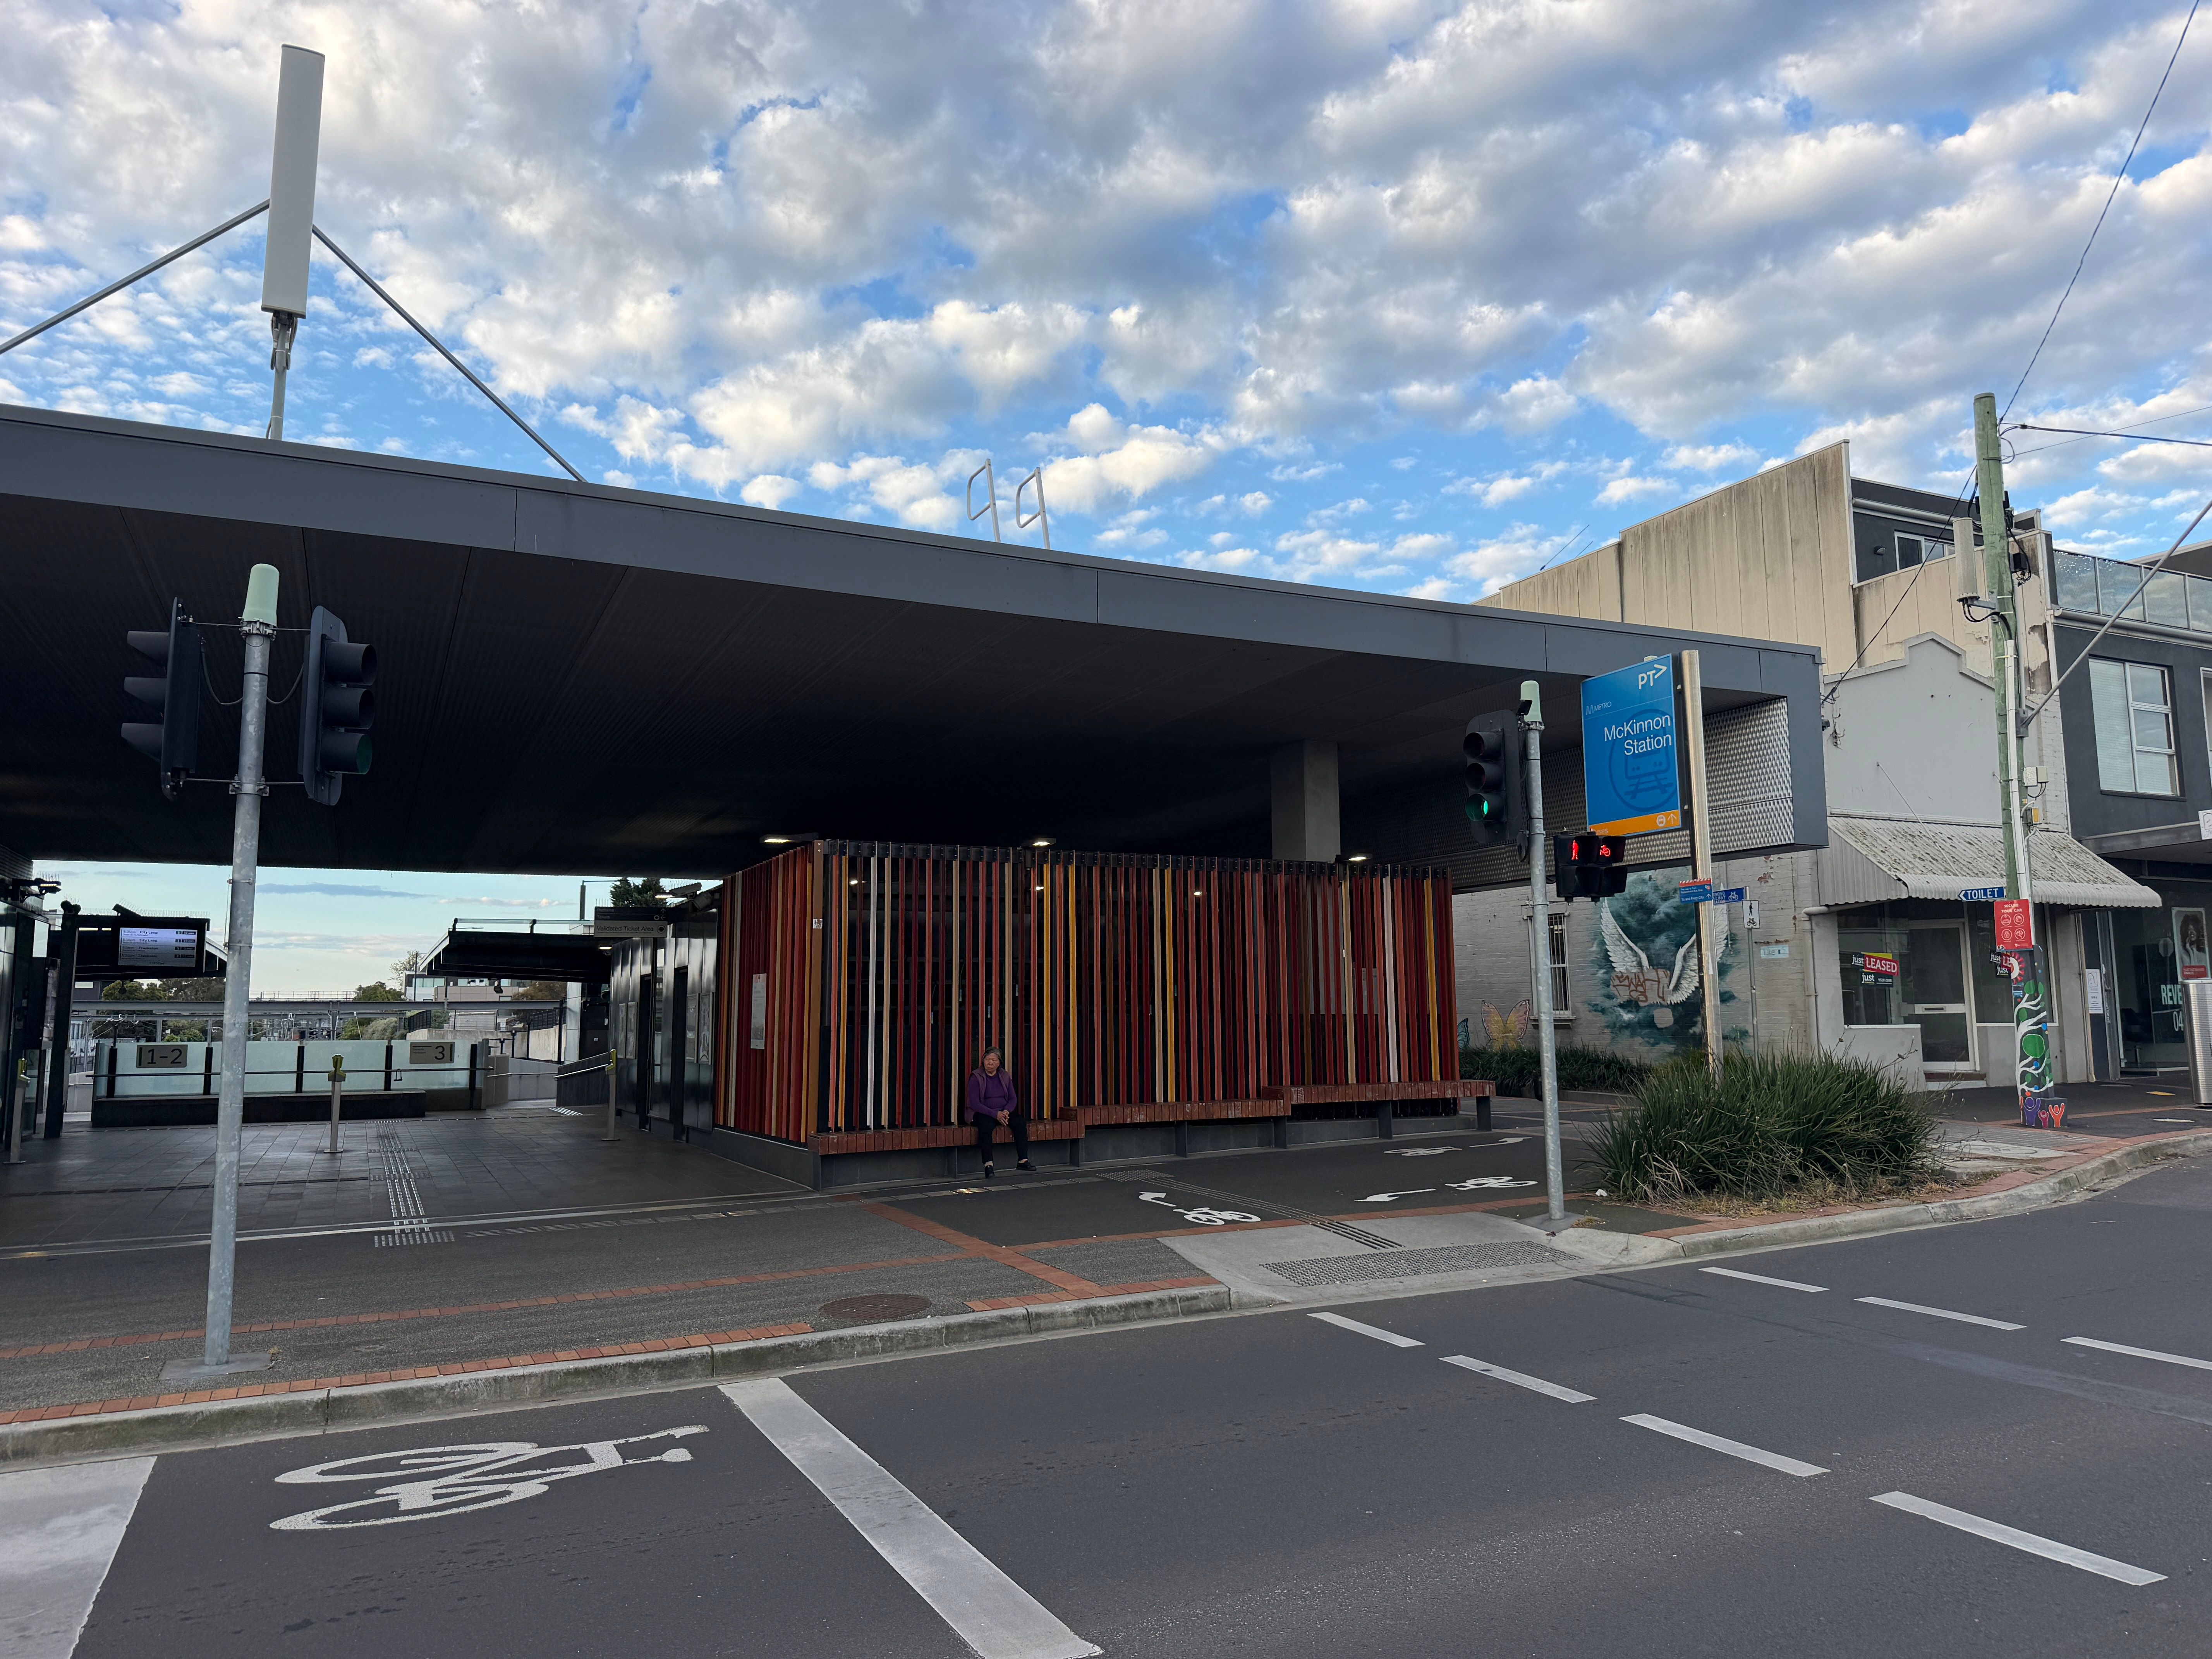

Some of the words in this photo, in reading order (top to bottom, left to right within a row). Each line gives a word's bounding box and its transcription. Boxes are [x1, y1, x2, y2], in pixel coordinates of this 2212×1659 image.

[1604, 715, 1670, 742] McKinnon
[1624, 734, 1672, 755] Station
[1966, 888, 1998, 900] TOILET
[1851, 955, 1864, 965] just
[1866, 957, 1897, 972] LEASED
[1990, 952, 2001, 962] just
[1862, 972, 1875, 983] just
[2160, 984, 2183, 1005] REVE
[2173, 1011, 2184, 1032] 04
[435, 1045, 445, 1060] 3
